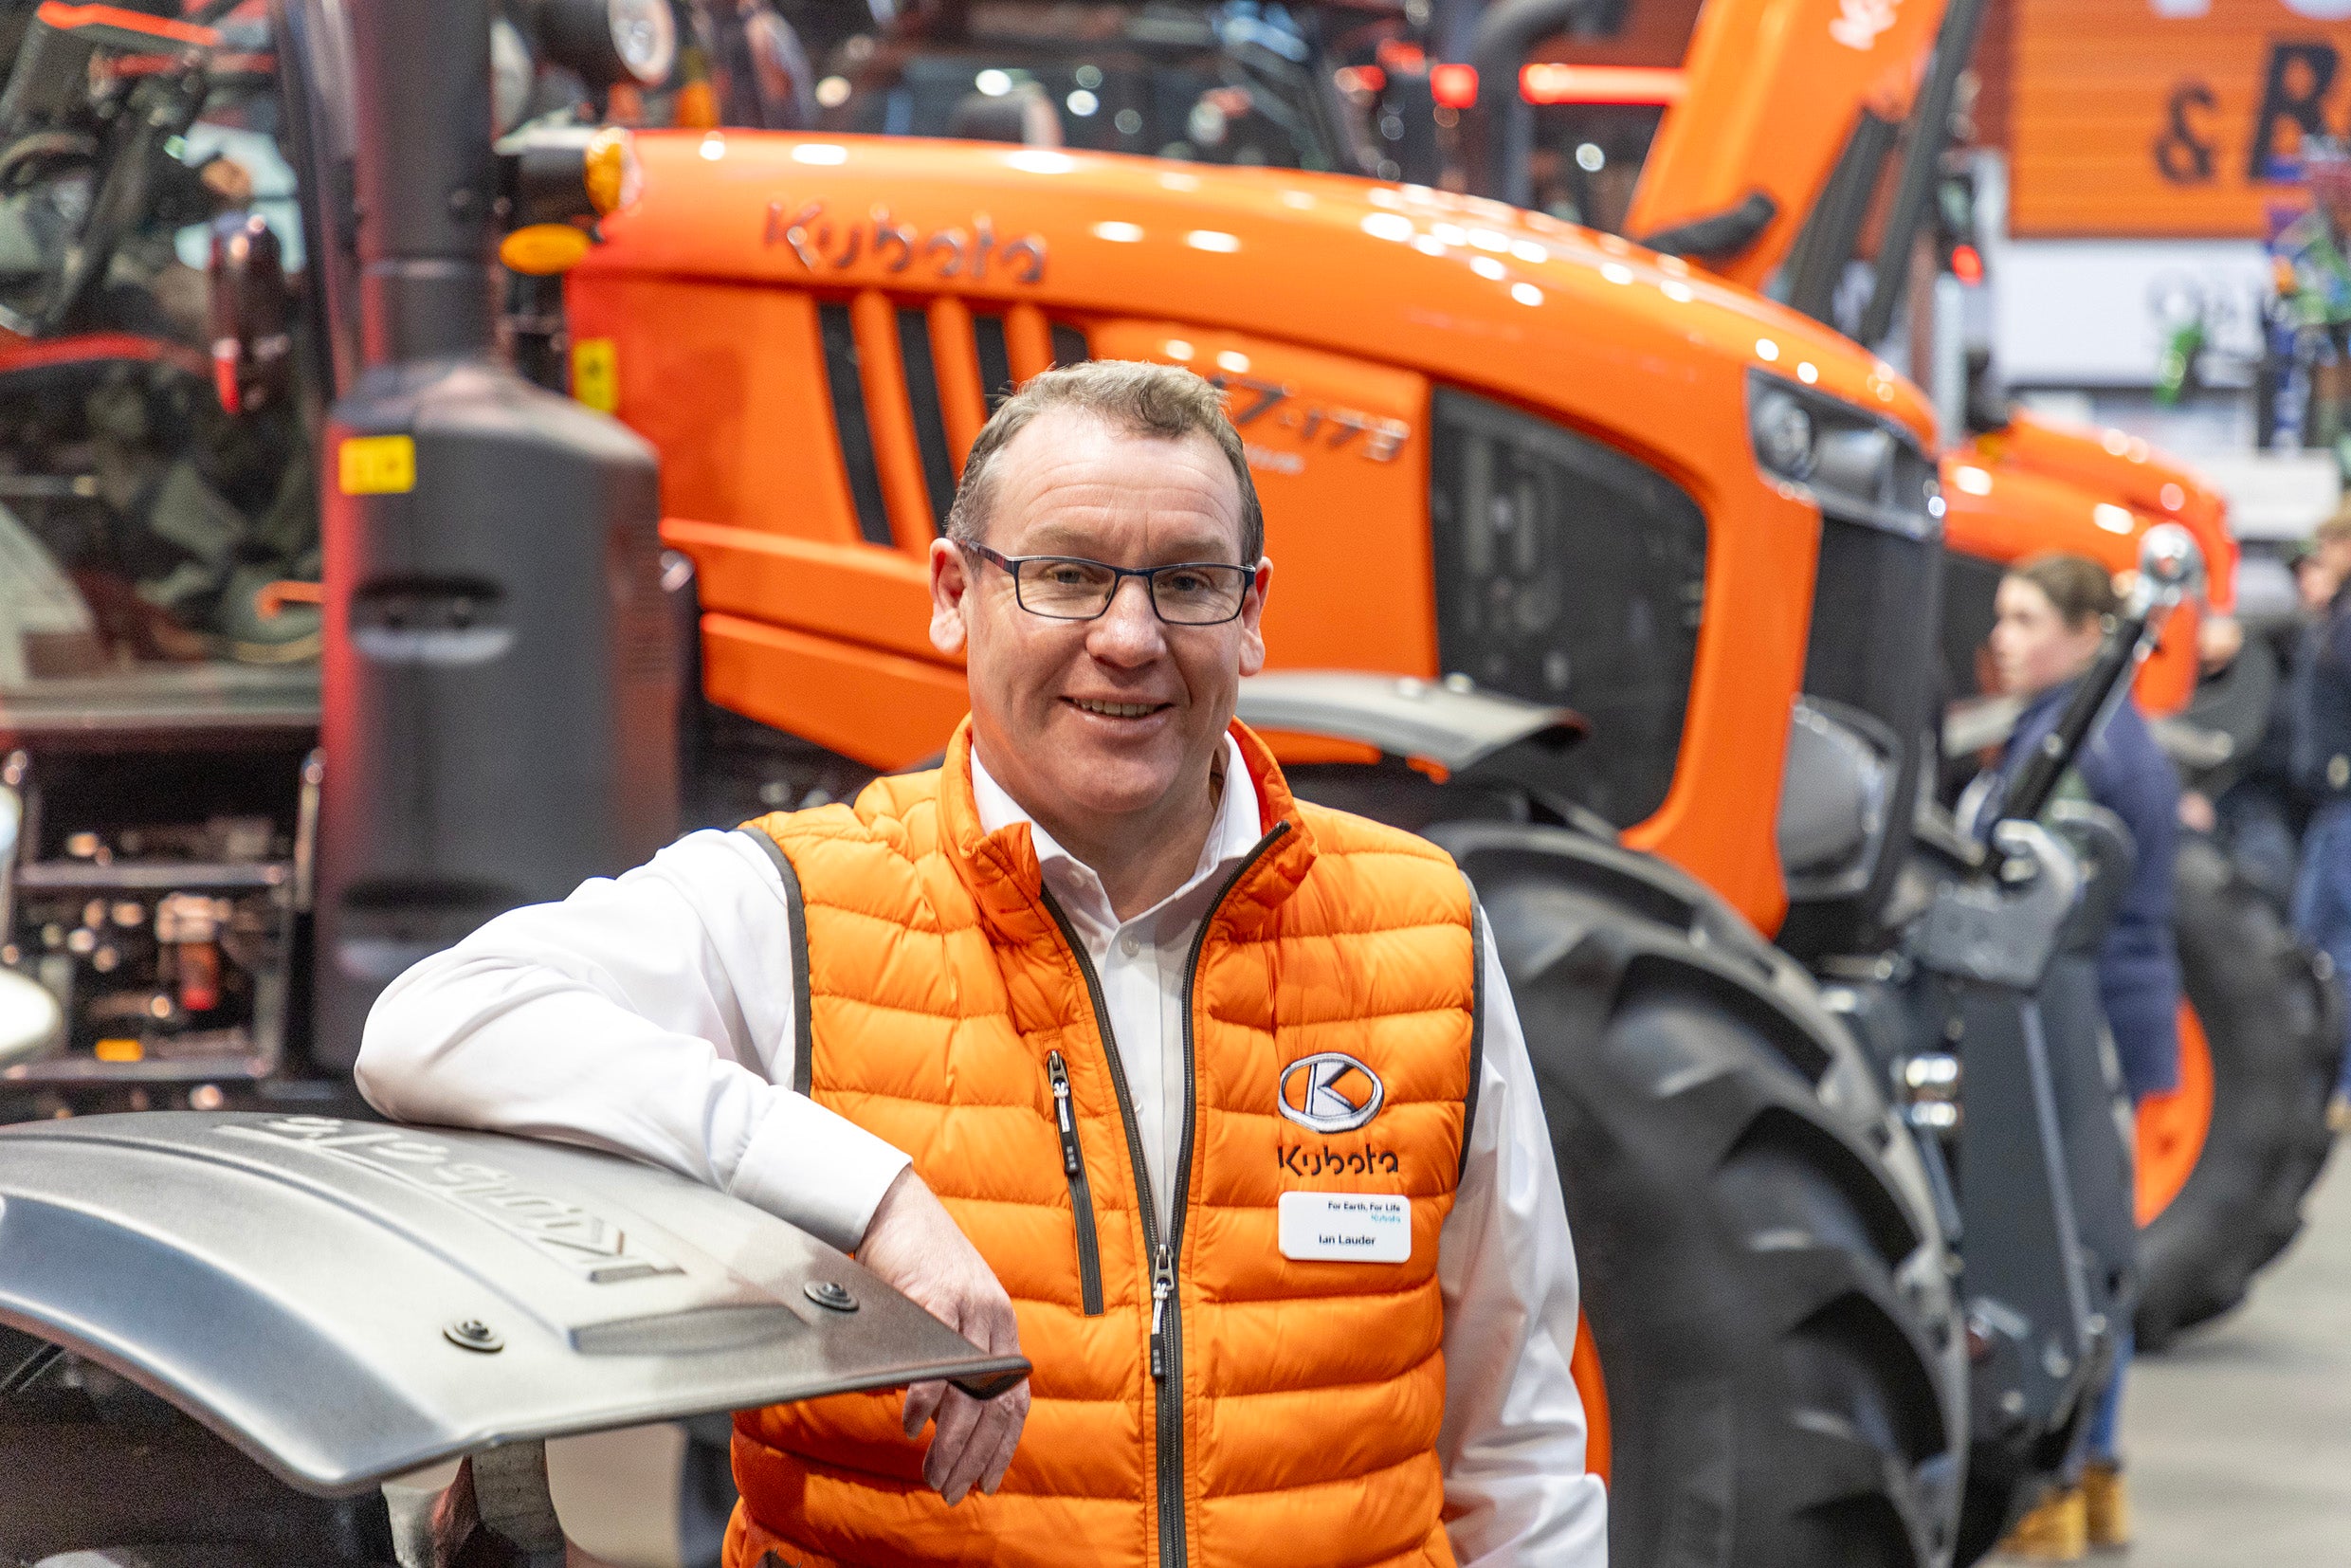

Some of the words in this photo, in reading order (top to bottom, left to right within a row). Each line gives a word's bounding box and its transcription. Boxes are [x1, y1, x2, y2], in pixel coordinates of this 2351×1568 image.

[765, 198, 1047, 283] Kubota
[1277, 1143, 1398, 1176] Kubota
[1327, 1201, 1340, 1210] For
[1343, 1201, 1368, 1212] Earth,
[1385, 1203, 1400, 1212] Life
[1319, 1234, 1335, 1245] Ian
[1339, 1234, 1375, 1246] Lauder
